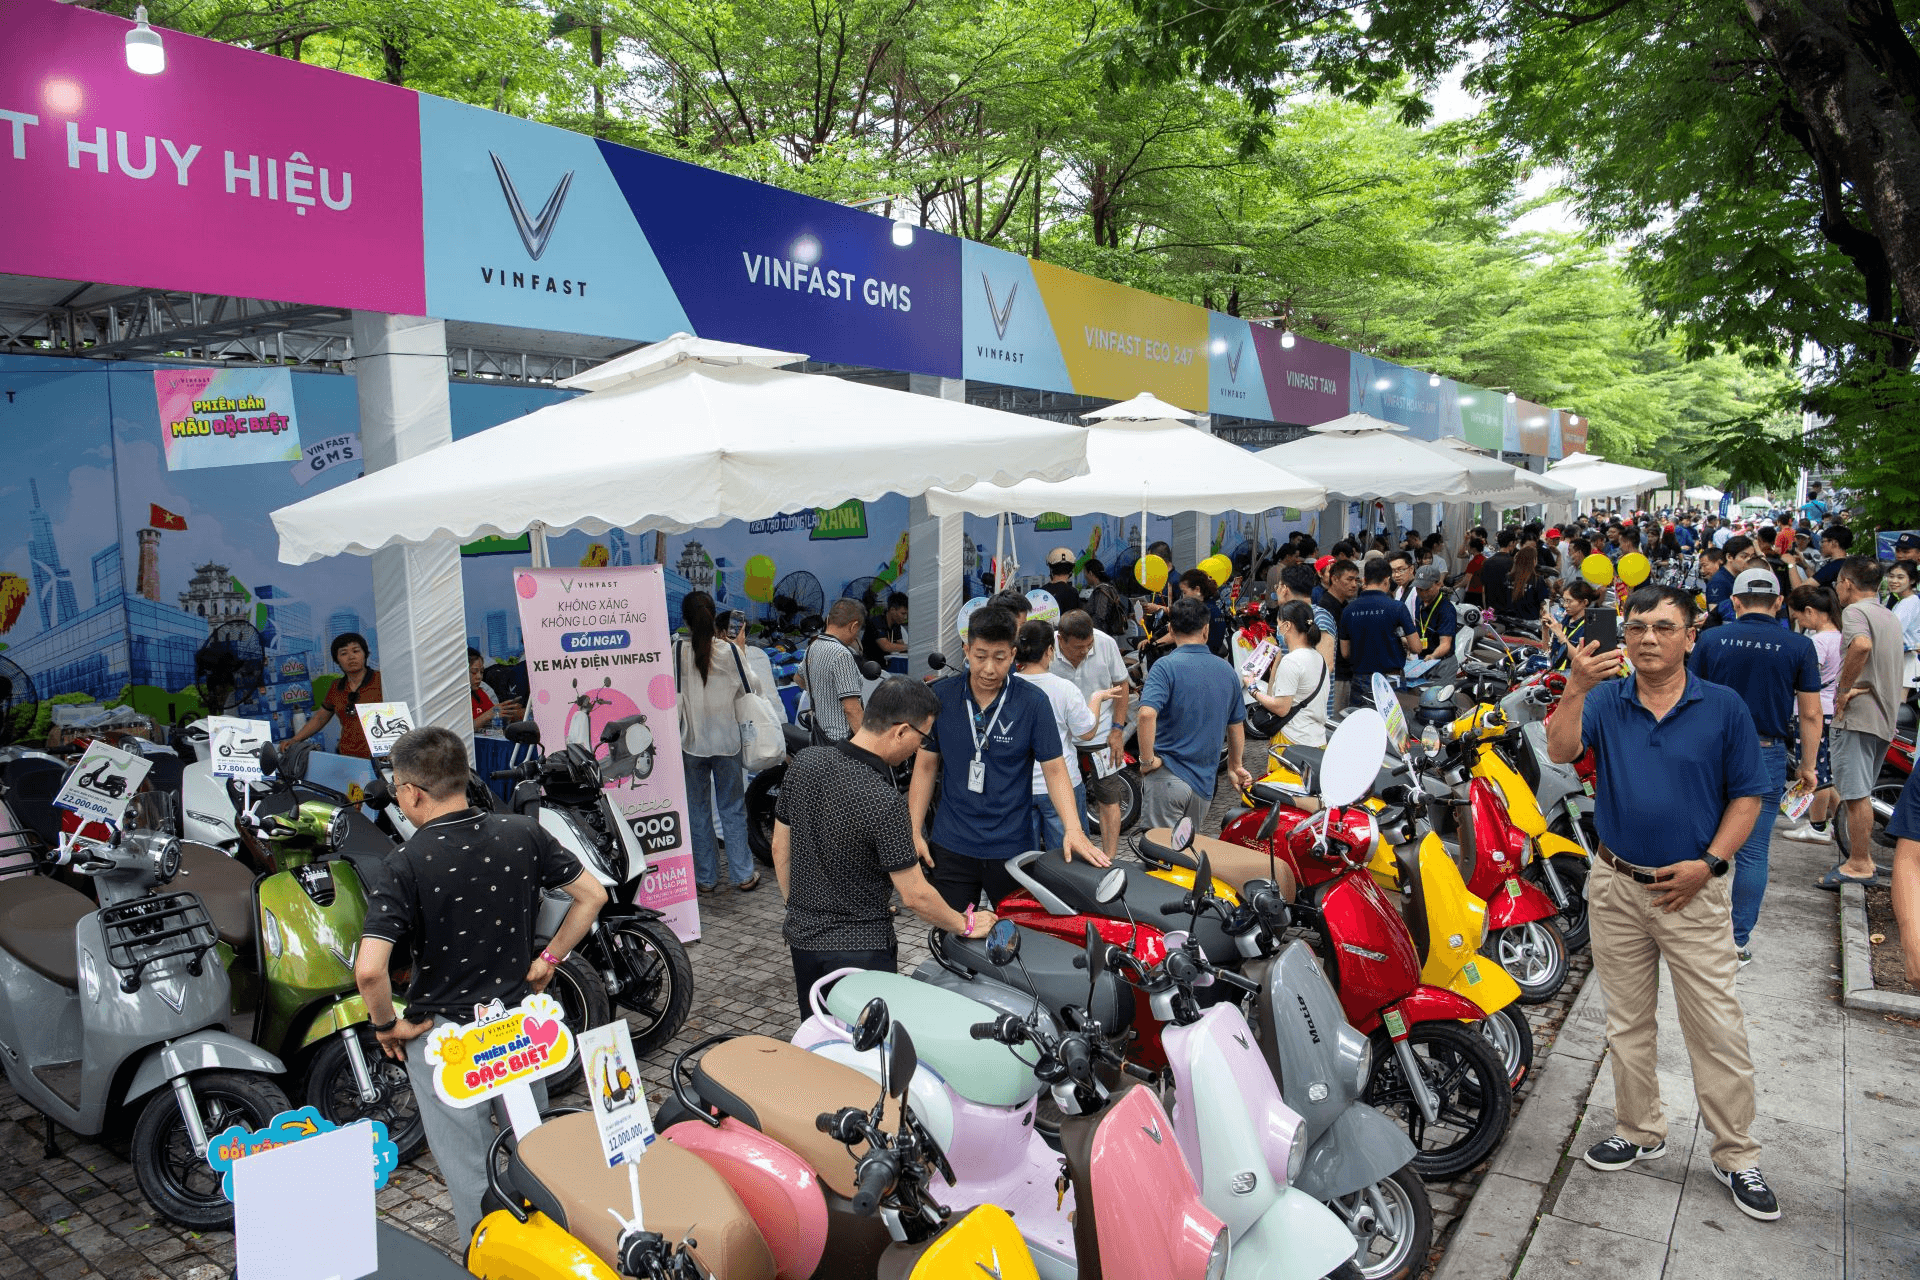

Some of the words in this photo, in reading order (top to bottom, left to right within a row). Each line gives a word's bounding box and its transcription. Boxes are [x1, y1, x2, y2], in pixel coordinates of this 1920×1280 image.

[66, 121, 202, 187] HUY
[224, 150, 352, 216] HIỆU
[480, 266, 587, 297] VINFAST
[742, 251, 856, 301] VINFAST
[863, 278, 912, 312] GMS
[977, 346, 1024, 364] VINFAST
[1084, 325, 1142, 357] VINFAST
[1145, 340, 1171, 363] ECO
[1173, 346, 1194, 366] 247
[1286, 370, 1319, 391] VINFAST
[1320, 377, 1337, 396] TAYA
[192, 396, 237, 414] PHIÊN
[238, 394, 265, 411] BẢN
[1220, 388, 1246, 400] VINFAST
[212, 414, 248, 438] ĐẶC
[249, 412, 289, 435] BIỆT
[306, 443, 325, 456] VIN
[325, 437, 350, 449] FAST
[310, 447, 354, 471] GMS
[819, 507, 861, 531] XANH
[577, 581, 618, 589] VINFAST
[558, 598, 597, 612] KHÔNG
[599, 597, 629, 611] XĂNG
[1351, 609, 1385, 617] VINFAST
[541, 614, 581, 628] KHÔNG
[582, 615, 597, 626] LO
[599, 612, 617, 625] GIÁ
[620, 612, 647, 624] TĂNG
[571, 631, 591, 648] ĐỔI
[593, 634, 624, 646] NGAY
[1720, 638, 1782, 652] VINFAST
[533, 660, 549, 672] XE
[551, 654, 578, 671] MÁY
[580, 653, 609, 671] ĐIỆN
[611, 652, 662, 666] VINFAST
[373, 744, 393, 752] 56.90
[217, 764, 262, 773] 17.800.000
[62, 794, 108, 814] 22.000.000
[633, 816, 675, 838] 000
[647, 835, 676, 849] VNĐ
[644, 873, 663, 894] 01
[662, 866, 687, 882] NĂM
[676, 878, 688, 888] PIN
[487, 1019, 520, 1035] VINFAST
[473, 1045, 507, 1065] PHIÊN
[507, 1034, 531, 1052] BẢN
[465, 1061, 508, 1089] ĐẶC
[508, 1043, 549, 1072] BIỆT
[608, 1123, 643, 1152] 12.000.000
